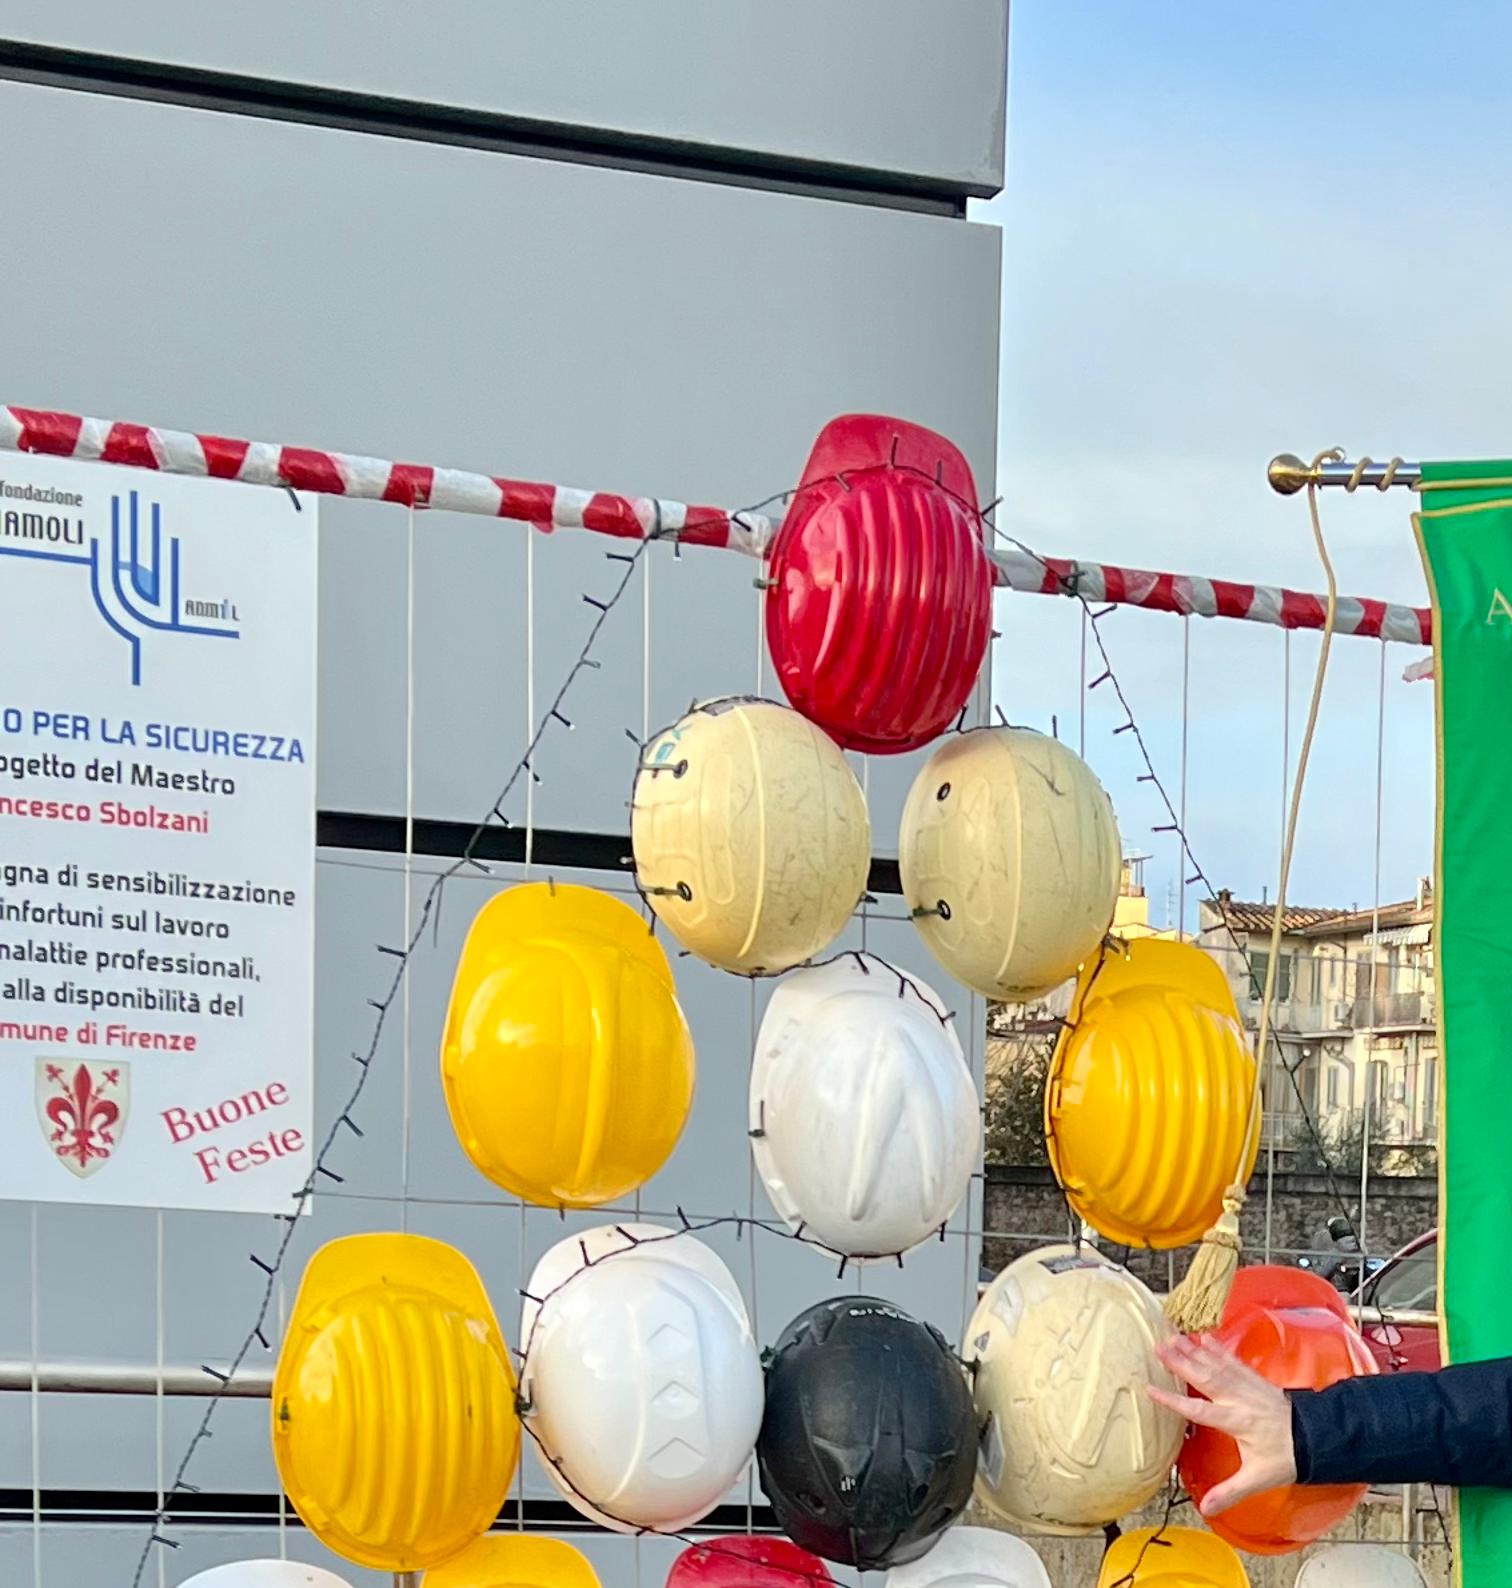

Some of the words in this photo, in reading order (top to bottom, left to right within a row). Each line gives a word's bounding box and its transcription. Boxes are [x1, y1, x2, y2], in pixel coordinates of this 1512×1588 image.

[0, 481, 83, 507] fondazione
[4, 708, 22, 733] O
[33, 711, 90, 741] PER
[101, 718, 136, 745] LA
[146, 723, 305, 763] SICUREZZA
[85, 758, 122, 784] del
[131, 763, 235, 795] Maestro
[100, 802, 209, 833] Sbolzani
[58, 864, 78, 887] di
[87, 868, 296, 906] sensibilizzazione
[112, 910, 147, 932] sul
[155, 912, 229, 939] lavoro
[96, 947, 260, 982] professionali,
[3, 978, 46, 1002] alla
[54, 981, 200, 1014] disponibilità
[209, 994, 244, 1017] del
[77, 1021, 97, 1045] di
[106, 1024, 196, 1051] Firenze
[160, 1081, 290, 1144] Buone
[194, 1128, 305, 1184] Feste
